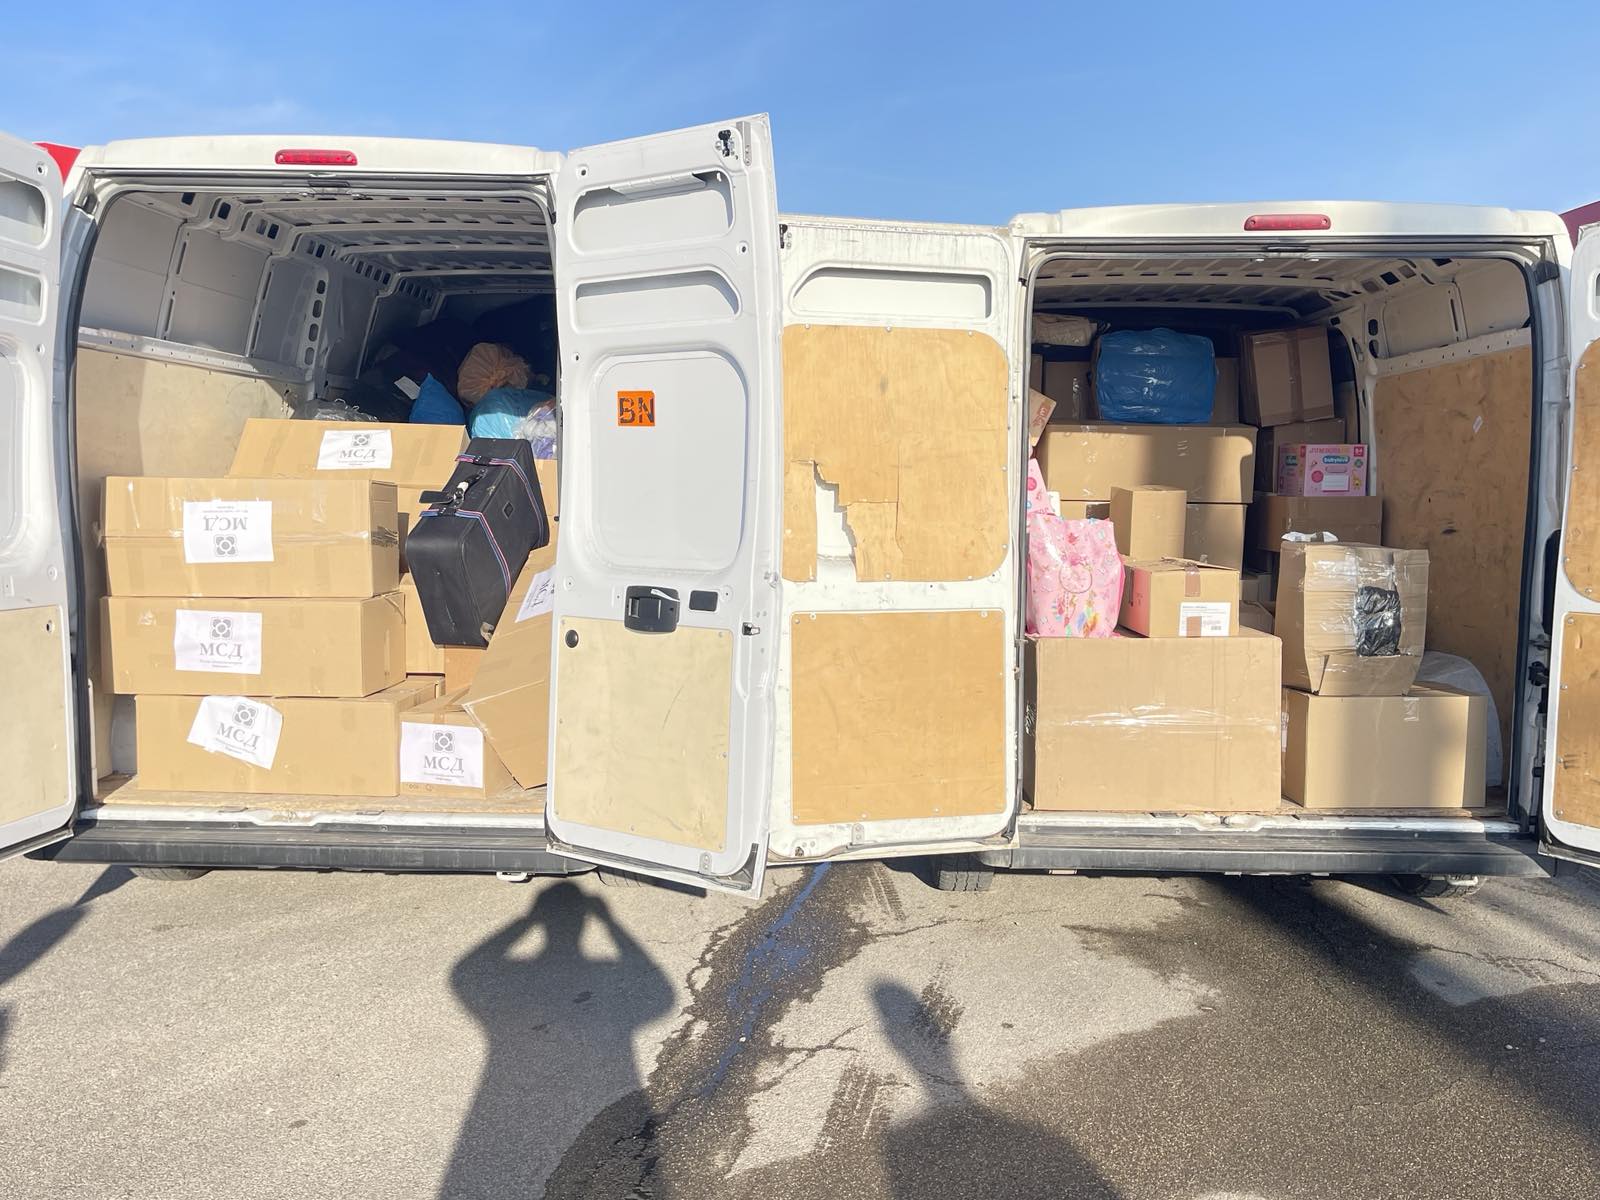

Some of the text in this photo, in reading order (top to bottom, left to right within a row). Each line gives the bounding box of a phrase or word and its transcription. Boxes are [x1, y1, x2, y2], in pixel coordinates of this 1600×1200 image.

[620, 397, 654, 423] BN
[340, 448, 377, 460] МСД
[203, 515, 248, 531] МСД
[200, 642, 243, 660] МСД
[217, 722, 260, 751] МСД
[424, 755, 464, 774] МСД
